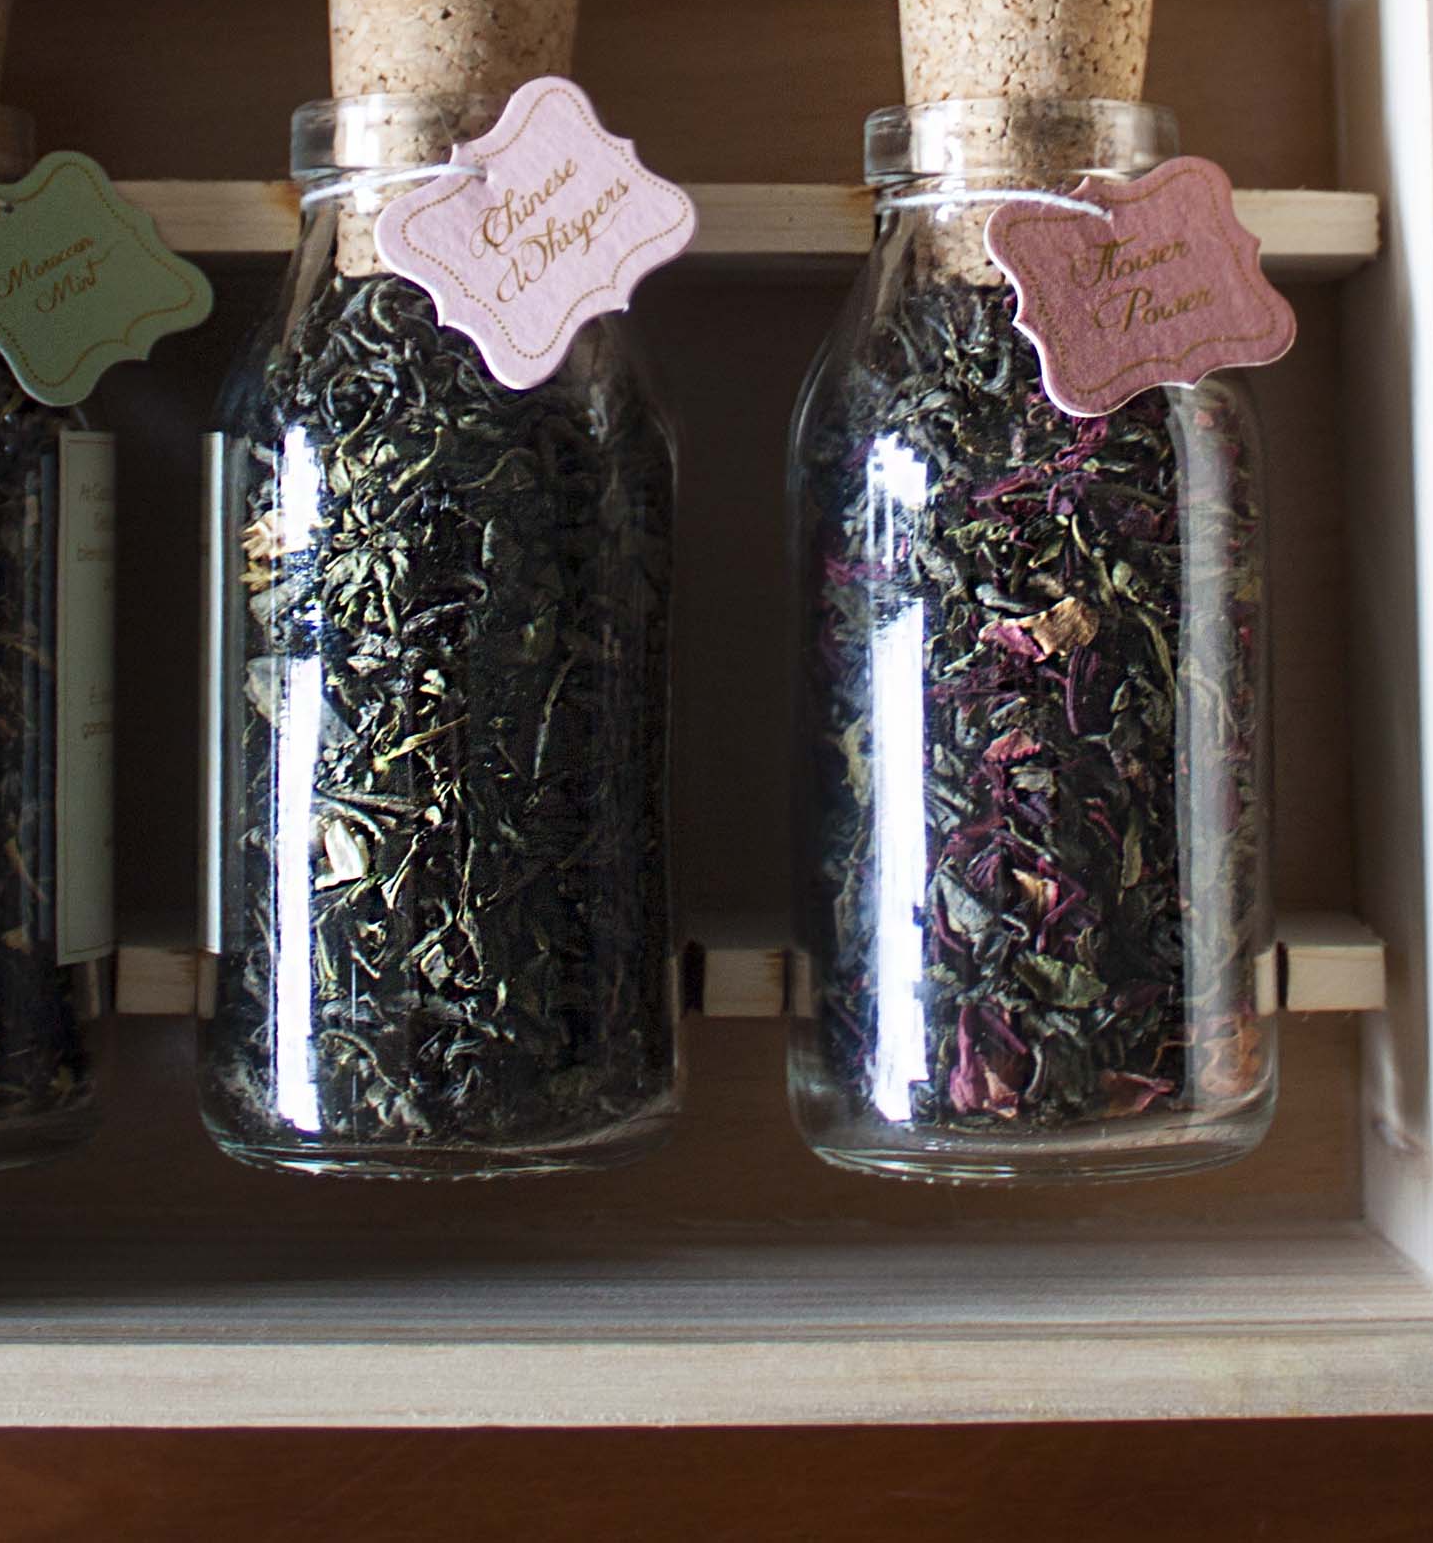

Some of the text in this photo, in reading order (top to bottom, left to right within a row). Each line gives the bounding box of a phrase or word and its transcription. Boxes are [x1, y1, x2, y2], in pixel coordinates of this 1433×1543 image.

[469, 158, 578, 259] Chinese
[496, 177, 631, 303] Whispers
[1092, 285, 1214, 333] Power
